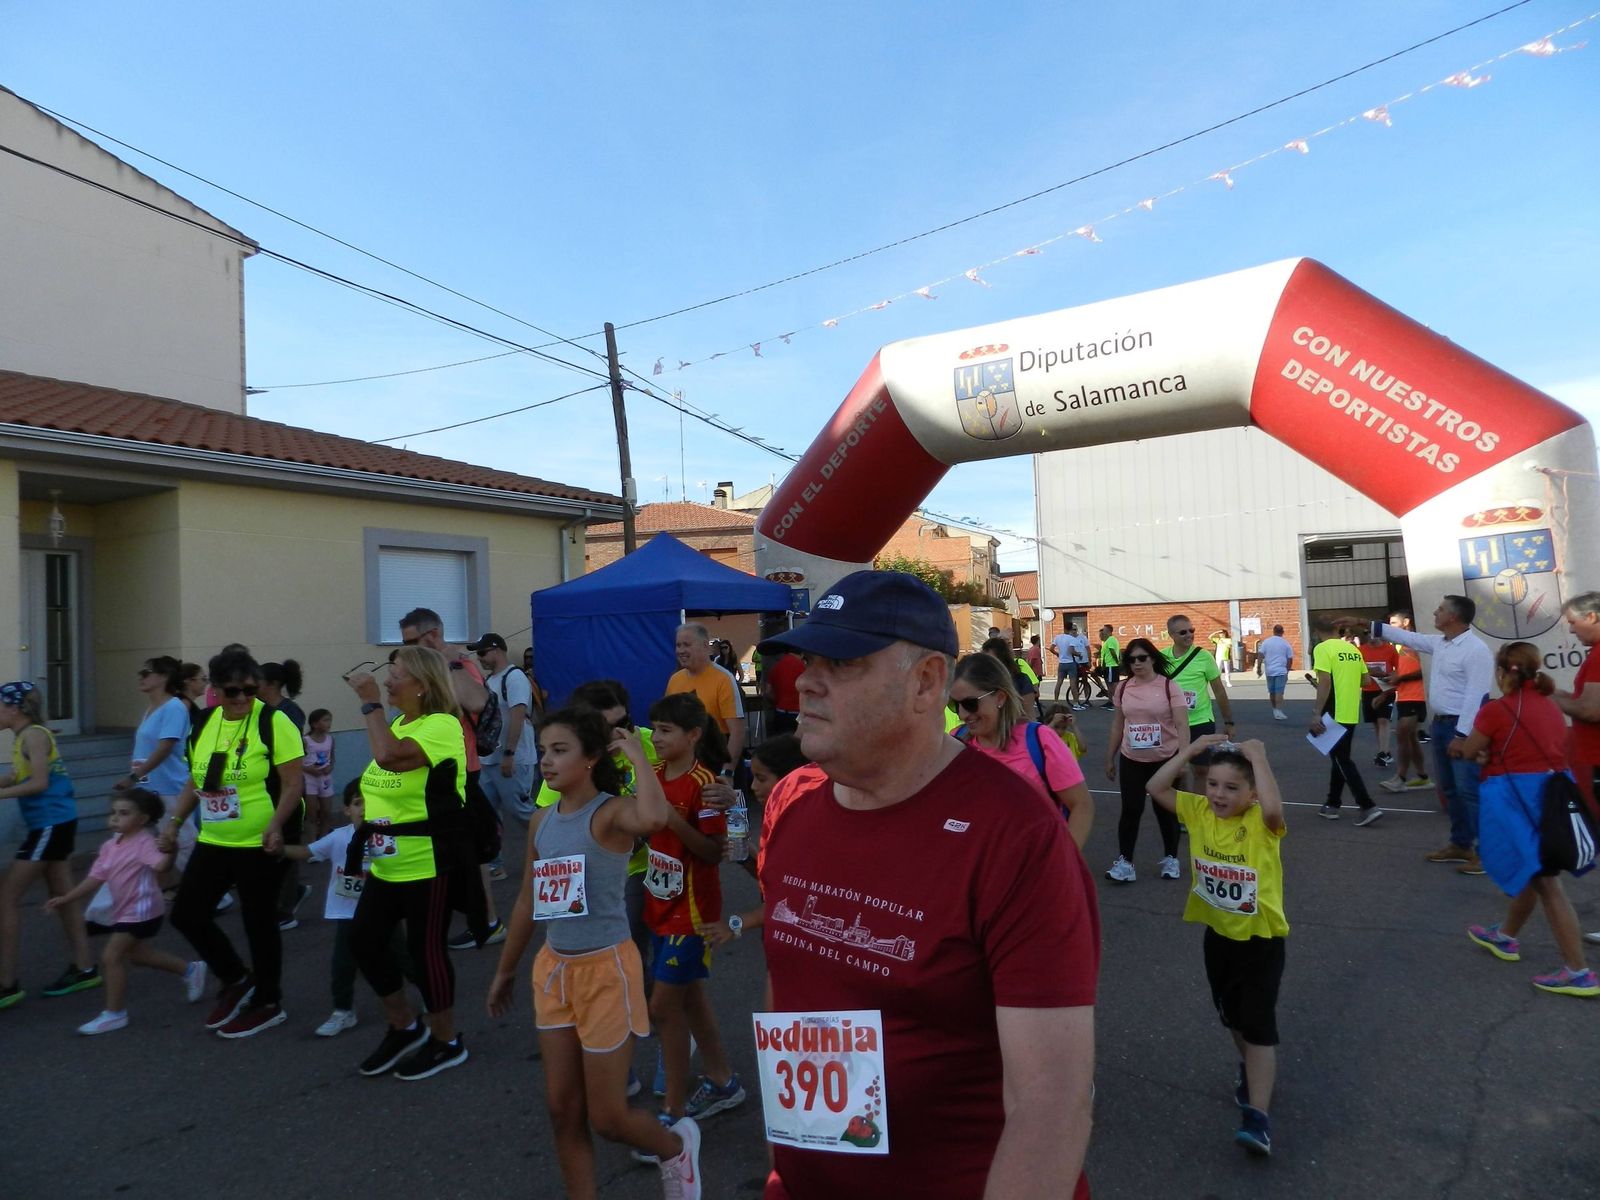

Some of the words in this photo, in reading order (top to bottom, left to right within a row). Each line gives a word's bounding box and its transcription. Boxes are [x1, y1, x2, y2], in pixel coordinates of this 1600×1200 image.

[1019, 328, 1153, 373] Diputación
[1025, 400, 1046, 417] de
[1053, 373, 1187, 413] Salamanca
[1292, 326, 1351, 368] CON
[1349, 359, 1500, 453] NUESTROS
[1280, 358, 1461, 473] DEPORTISTAS
[773, 501, 804, 539] CON
[801, 481, 823, 503] EL
[819, 396, 887, 480] DEPORTE
[1134, 733, 1153, 742] 441
[381, 779, 402, 789] 2025
[649, 853, 683, 873] dunia
[650, 868, 669, 889] 41
[1194, 858, 1256, 882] bedunia
[539, 878, 571, 903] 427
[782, 874, 807, 889] MEDIA
[809, 881, 862, 902] MARATÓN
[864, 895, 925, 922] POPULAR
[1204, 876, 1242, 901] 560
[773, 929, 813, 952] MEDINA
[819, 945, 841, 961] DEL
[846, 954, 891, 977] CAMPO
[755, 1019, 878, 1053] bedunia
[776, 1059, 849, 1113] 390
